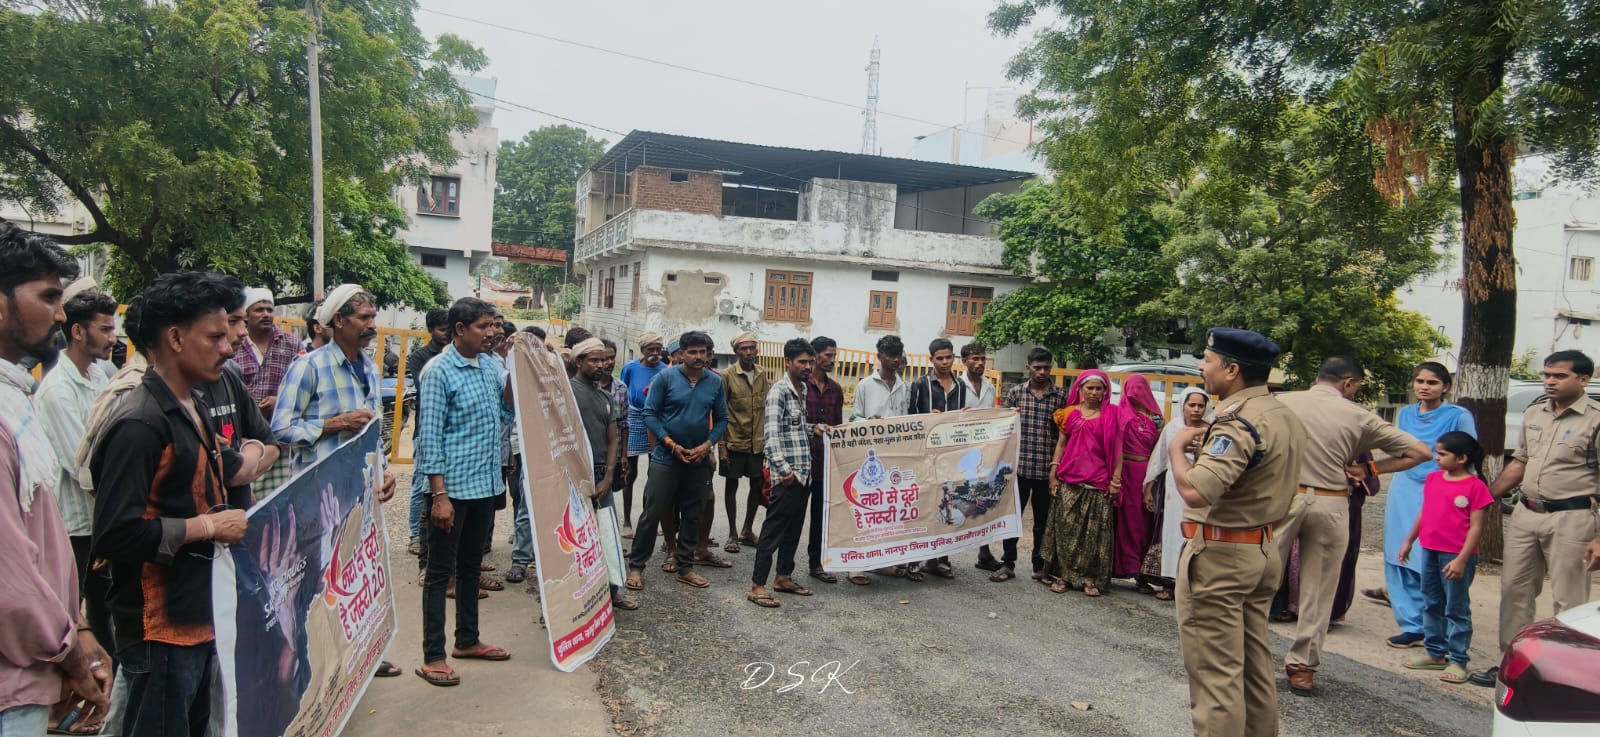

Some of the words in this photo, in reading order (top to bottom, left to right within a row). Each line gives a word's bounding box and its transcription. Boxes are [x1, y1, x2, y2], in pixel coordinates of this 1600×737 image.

[850, 426, 868, 438] NO
[870, 425, 885, 436] TO
[888, 421, 924, 434] DRUGS
[860, 488, 884, 506] नशे
[886, 486, 898, 504] से
[900, 483, 919, 508] दूरी
[854, 508, 863, 528] है
[864, 506, 897, 528] ज़रूरी
[900, 507, 918, 522] 2.0
[281, 555, 308, 583] DRUGS
